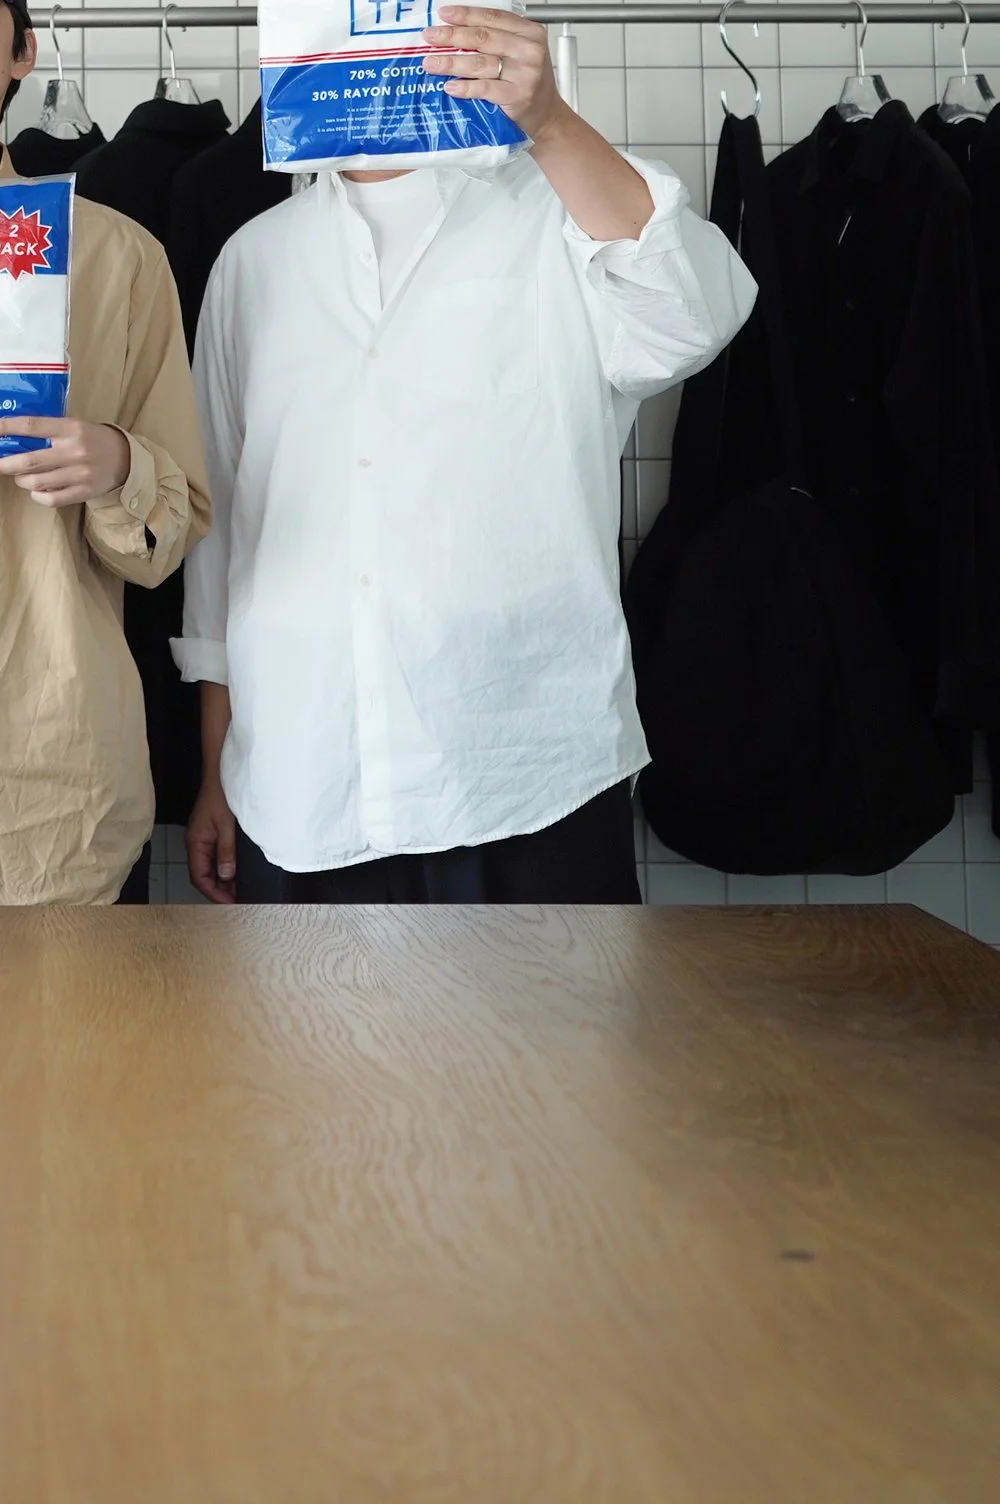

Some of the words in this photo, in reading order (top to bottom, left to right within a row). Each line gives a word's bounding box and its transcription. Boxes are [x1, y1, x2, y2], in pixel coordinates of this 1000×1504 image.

[349, 69, 377, 81] 70%
[381, 65, 429, 78] COTTO
[311, 90, 339, 102] 30%
[343, 86, 391, 99] RAYON
[396, 81, 445, 97] (LUNAC
[9, 224, 20, 238] 2
